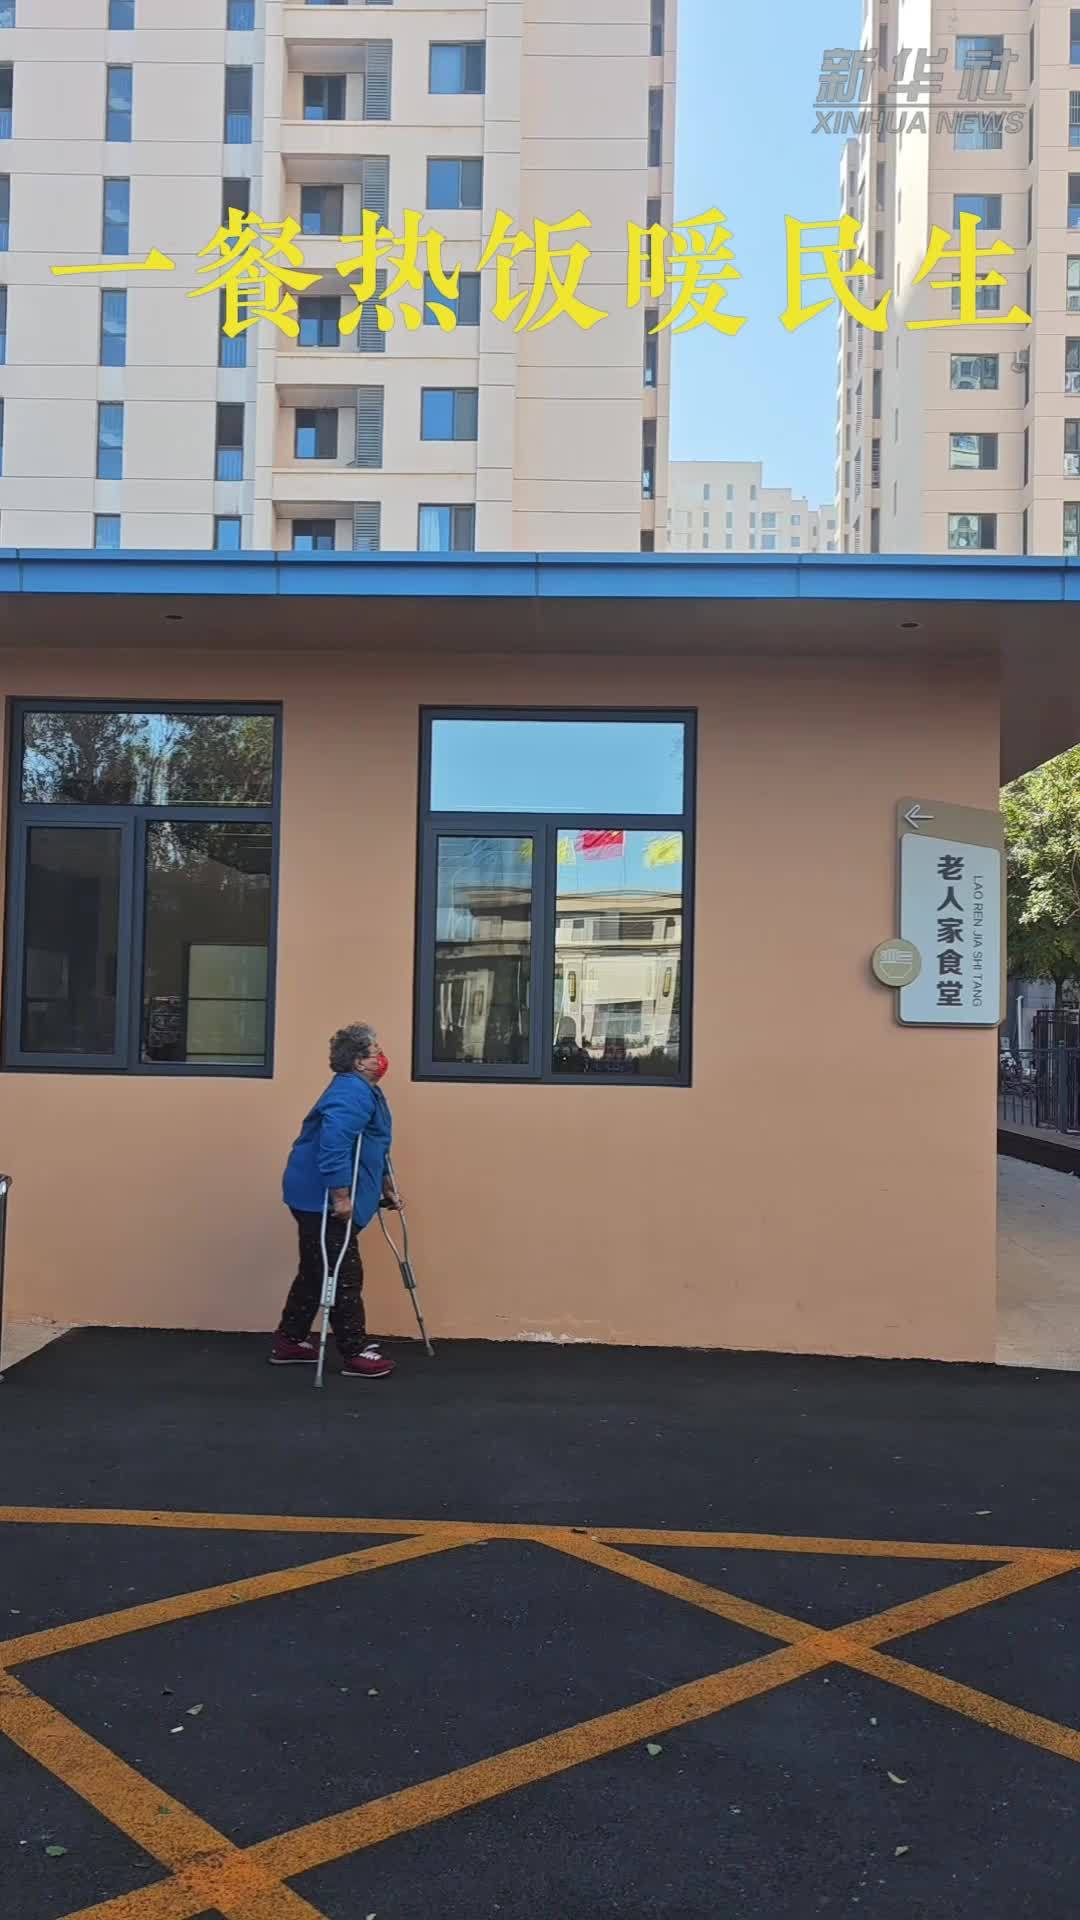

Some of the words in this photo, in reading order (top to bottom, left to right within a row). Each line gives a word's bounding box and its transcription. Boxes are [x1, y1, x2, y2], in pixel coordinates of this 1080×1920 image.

[973, 875, 984, 900] LAO
[973, 902, 984, 927] REN
[936, 854, 965, 1007] 老人家食堂
[973, 929, 984, 949] JIA
[972, 951, 984, 971] SHI
[972, 973, 984, 1007] TANG
